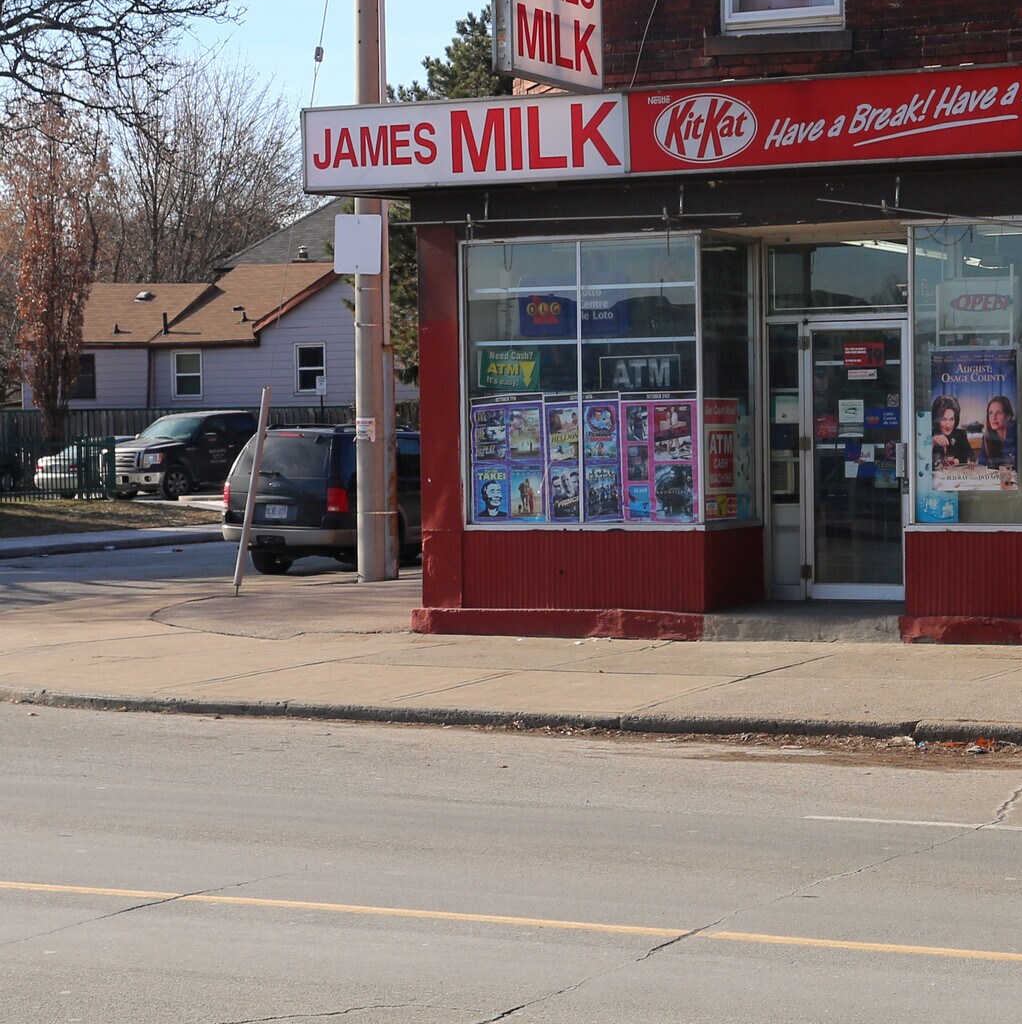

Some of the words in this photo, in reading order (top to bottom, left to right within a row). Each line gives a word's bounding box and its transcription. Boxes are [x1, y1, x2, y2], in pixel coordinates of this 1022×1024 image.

[516, 2, 599, 77] MILK
[764, 118, 824, 150] Have
[828, 116, 844, 138] a
[847, 89, 937, 135] Break!
[934, 82, 998, 121] Have
[664, 98, 748, 158] KitKat
[313, 122, 438, 170] JAMES
[450, 101, 622, 174] MILK
[580, 289, 602, 297] otto
[955, 294, 1010, 312] OPEN
[592, 310, 614, 320] Loto
[489, 351, 509, 360] Need
[511, 351, 533, 359] Cash?
[486, 362, 520, 376] ATM
[613, 358, 671, 388] ATM
[956, 364, 993, 374] AUGUST:
[486, 375, 498, 385] It's
[500, 377, 519, 387] easy!
[941, 373, 970, 383] OSAGE
[970, 373, 1007, 383] COUNTY
[709, 434, 733, 454] ATM
[713, 458, 728, 469] CASH
[477, 472, 507, 481] TAKEI
[709, 472, 733, 484] MACHINE
